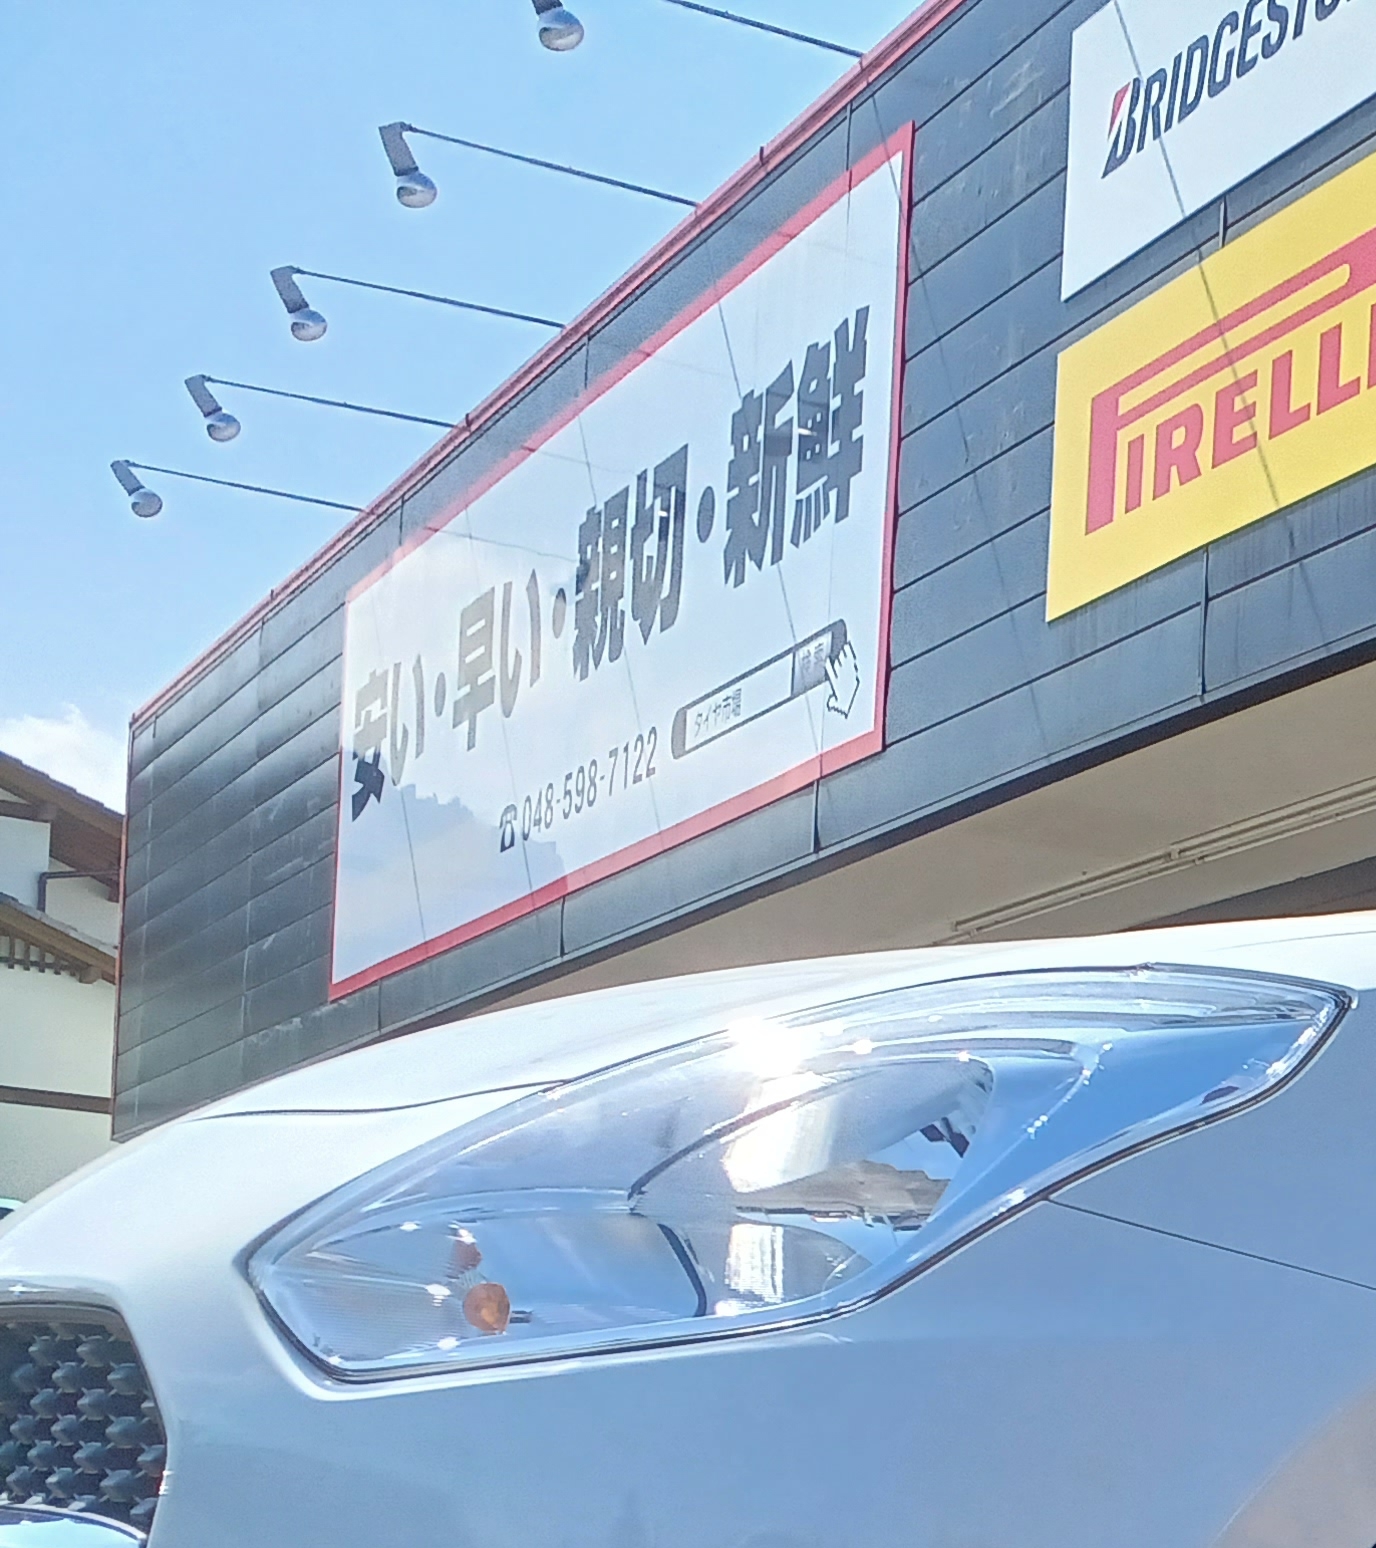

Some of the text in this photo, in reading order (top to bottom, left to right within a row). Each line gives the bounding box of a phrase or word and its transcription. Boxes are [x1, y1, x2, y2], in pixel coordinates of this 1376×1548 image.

[693, 687, 742, 738] タイヤ市場
[521, 726, 658, 842] 048-598-7122
